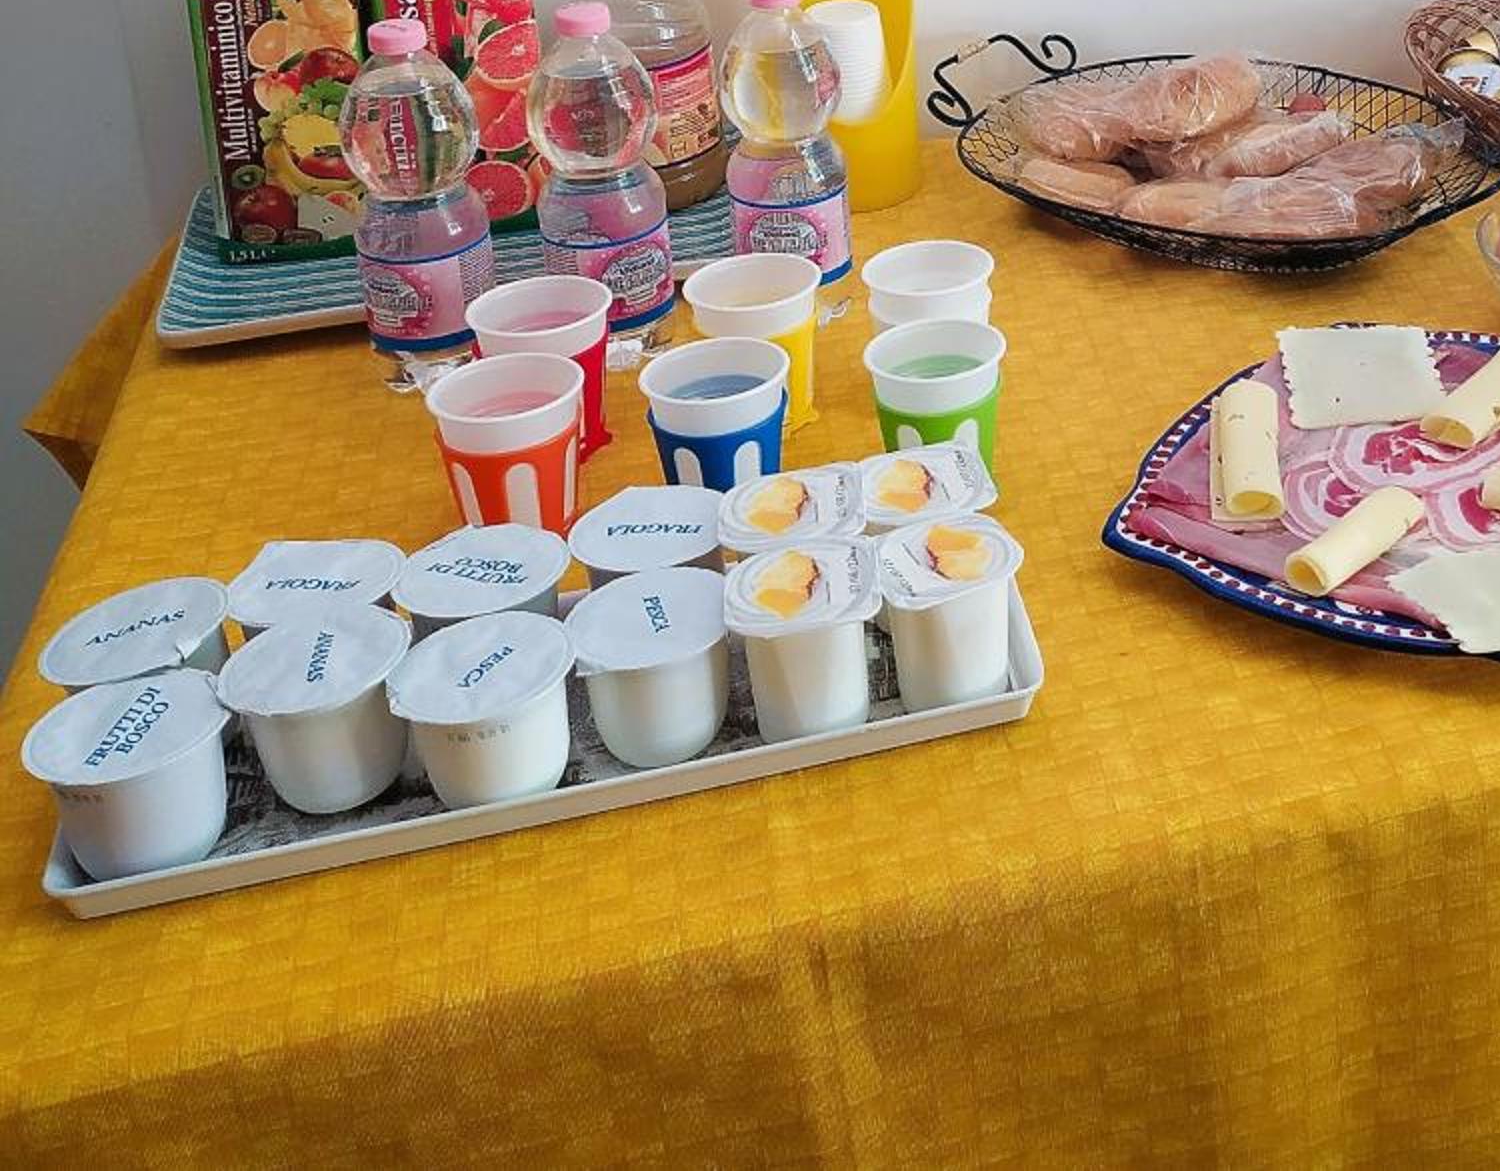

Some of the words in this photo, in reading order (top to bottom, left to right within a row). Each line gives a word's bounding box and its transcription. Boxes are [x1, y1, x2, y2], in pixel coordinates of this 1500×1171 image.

[208, 1, 251, 161] Multivitaminico
[607, 523, 703, 537] FRAGOLA
[425, 562, 453, 575] DI
[451, 567, 528, 584] FRUTTI
[455, 556, 523, 573] BOSCO
[265, 578, 361, 590] FRAGOLA
[84, 610, 185, 647] ANANAS
[642, 595, 671, 633] PESCA
[305, 630, 335, 683] ANANAS
[457, 645, 514, 689] PESCA
[83, 708, 143, 766] FRUTTI
[136, 686, 161, 707] DI
[113, 701, 169, 754] BOSCO
